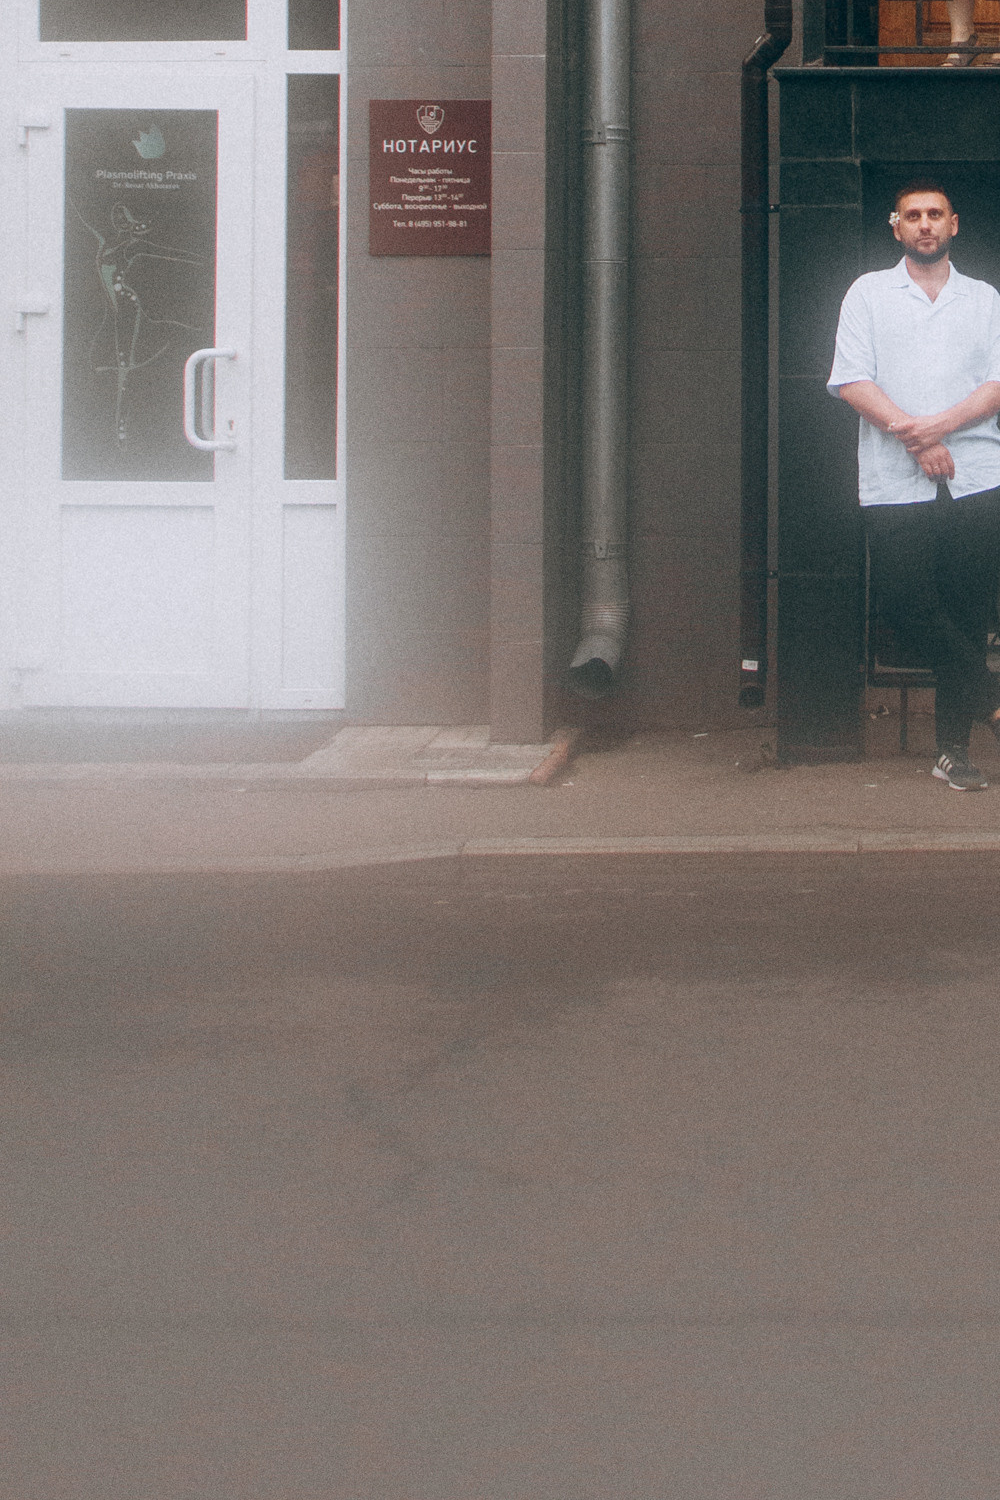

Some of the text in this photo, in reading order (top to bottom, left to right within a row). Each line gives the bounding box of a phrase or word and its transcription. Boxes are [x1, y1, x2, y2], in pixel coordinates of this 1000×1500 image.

[382, 139, 477, 154] НОТАРИУС
[96, 169, 197, 182] Plasmolifting Praxis
[408, 167, 453, 176] Часы работы
[389, 176, 436, 184] Понедельник
[401, 193, 432, 202] Перерыв
[453, 202, 488, 211] выходной
